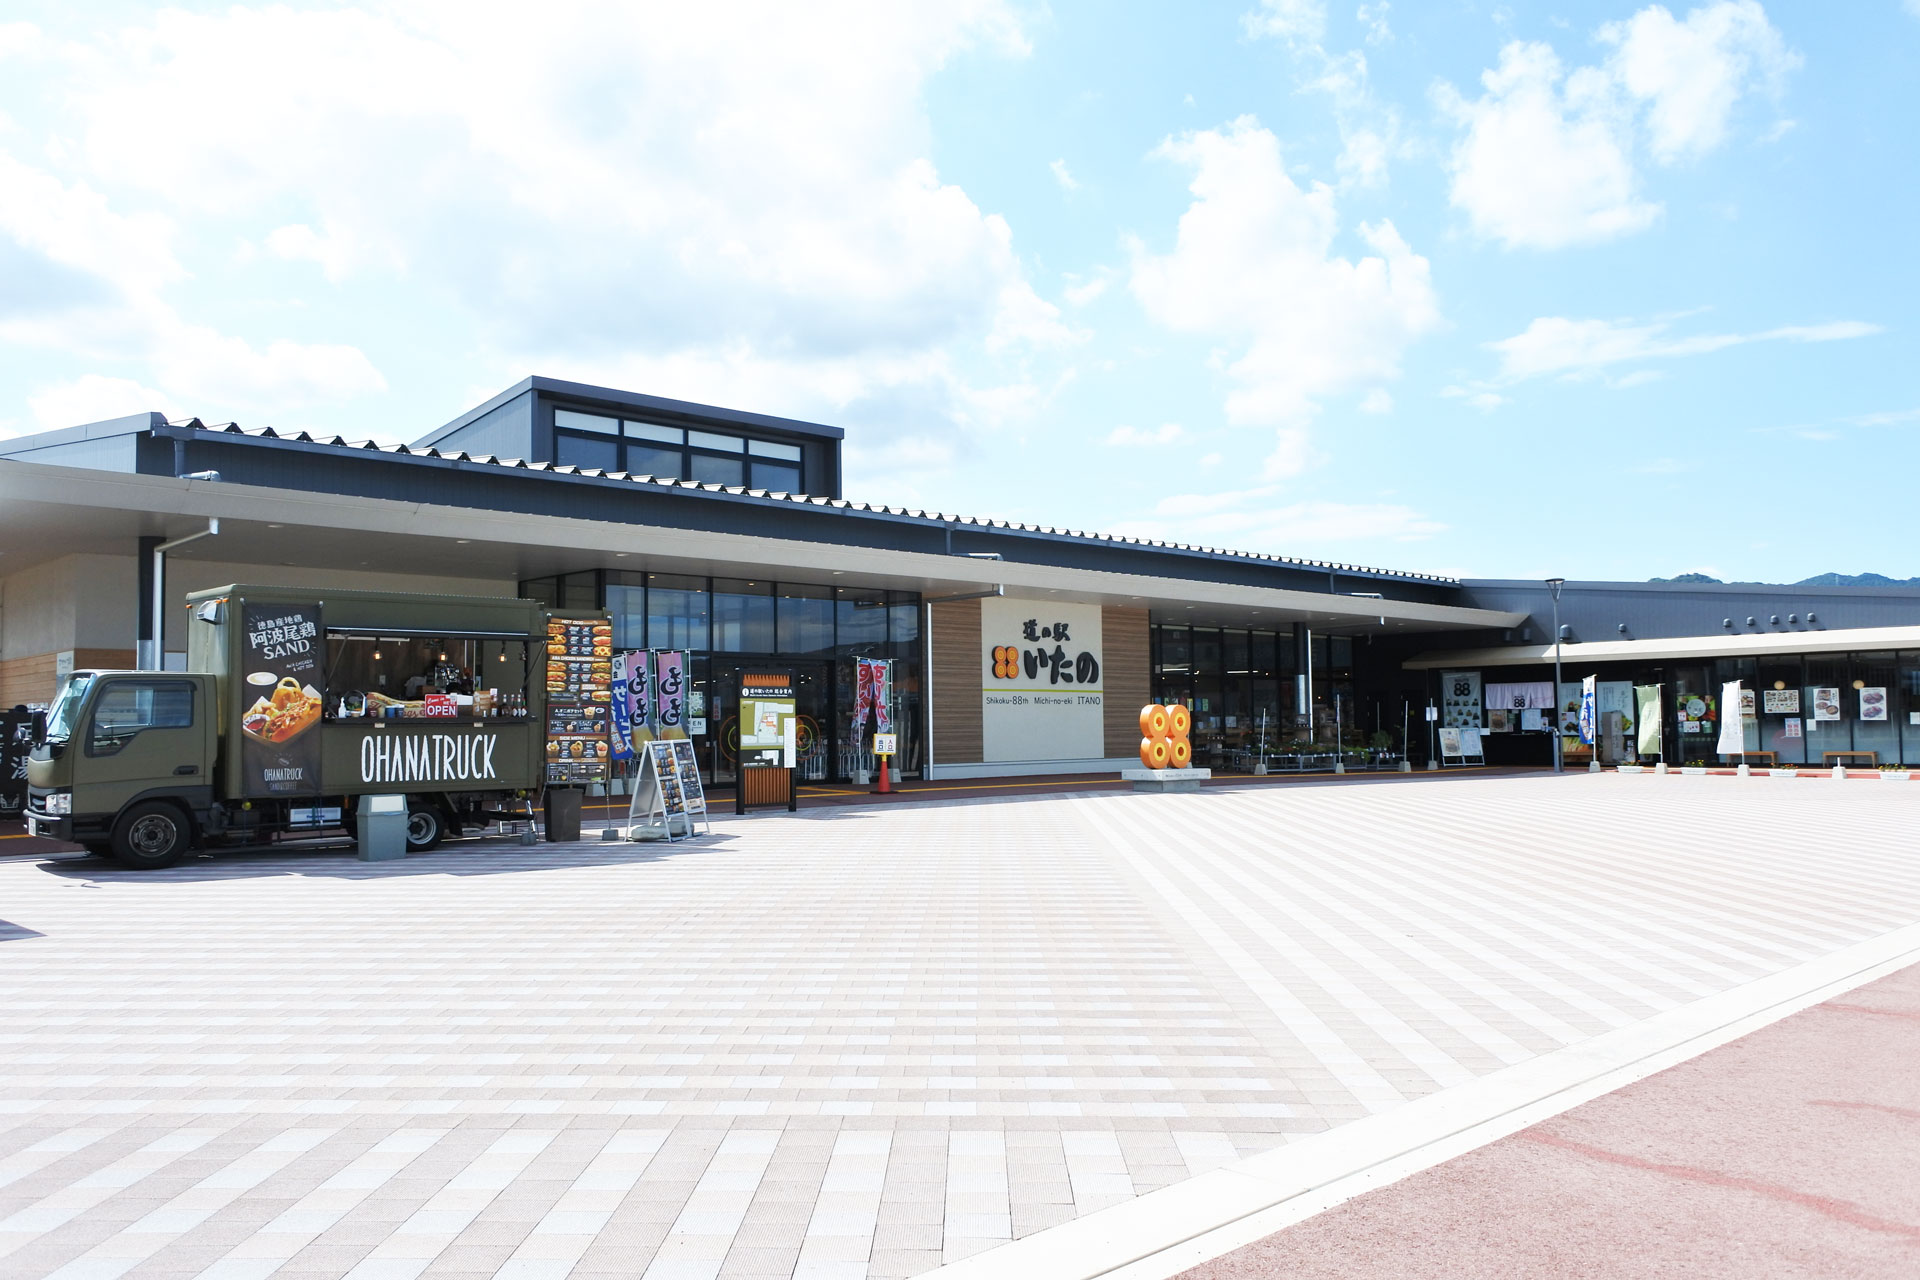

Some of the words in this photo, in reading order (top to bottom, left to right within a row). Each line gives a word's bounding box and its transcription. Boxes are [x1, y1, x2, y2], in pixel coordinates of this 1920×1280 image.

[249, 621, 316, 649] 阿波尾鶏
[1022, 619, 1071, 642] 道の駅
[263, 639, 310, 660] SAND
[992, 645, 1019, 679] 88
[1023, 644, 1099, 685] いたの
[627, 665, 648, 727] もも
[660, 666, 683, 726] もも
[1454, 682, 1471, 697] 88
[986, 695, 1029, 705] Shikoku-88th
[1034, 696, 1073, 705] Michi-no-eki
[1077, 696, 1101, 705] ITANO
[1513, 698, 1526, 708] 88
[427, 705, 456, 716] OPEN
[878, 739, 884, 750] 出口
[888, 739, 893, 750] 入口
[361, 734, 496, 782] OHANATRUCK
[263, 767, 303, 781] OHANATRUCK
